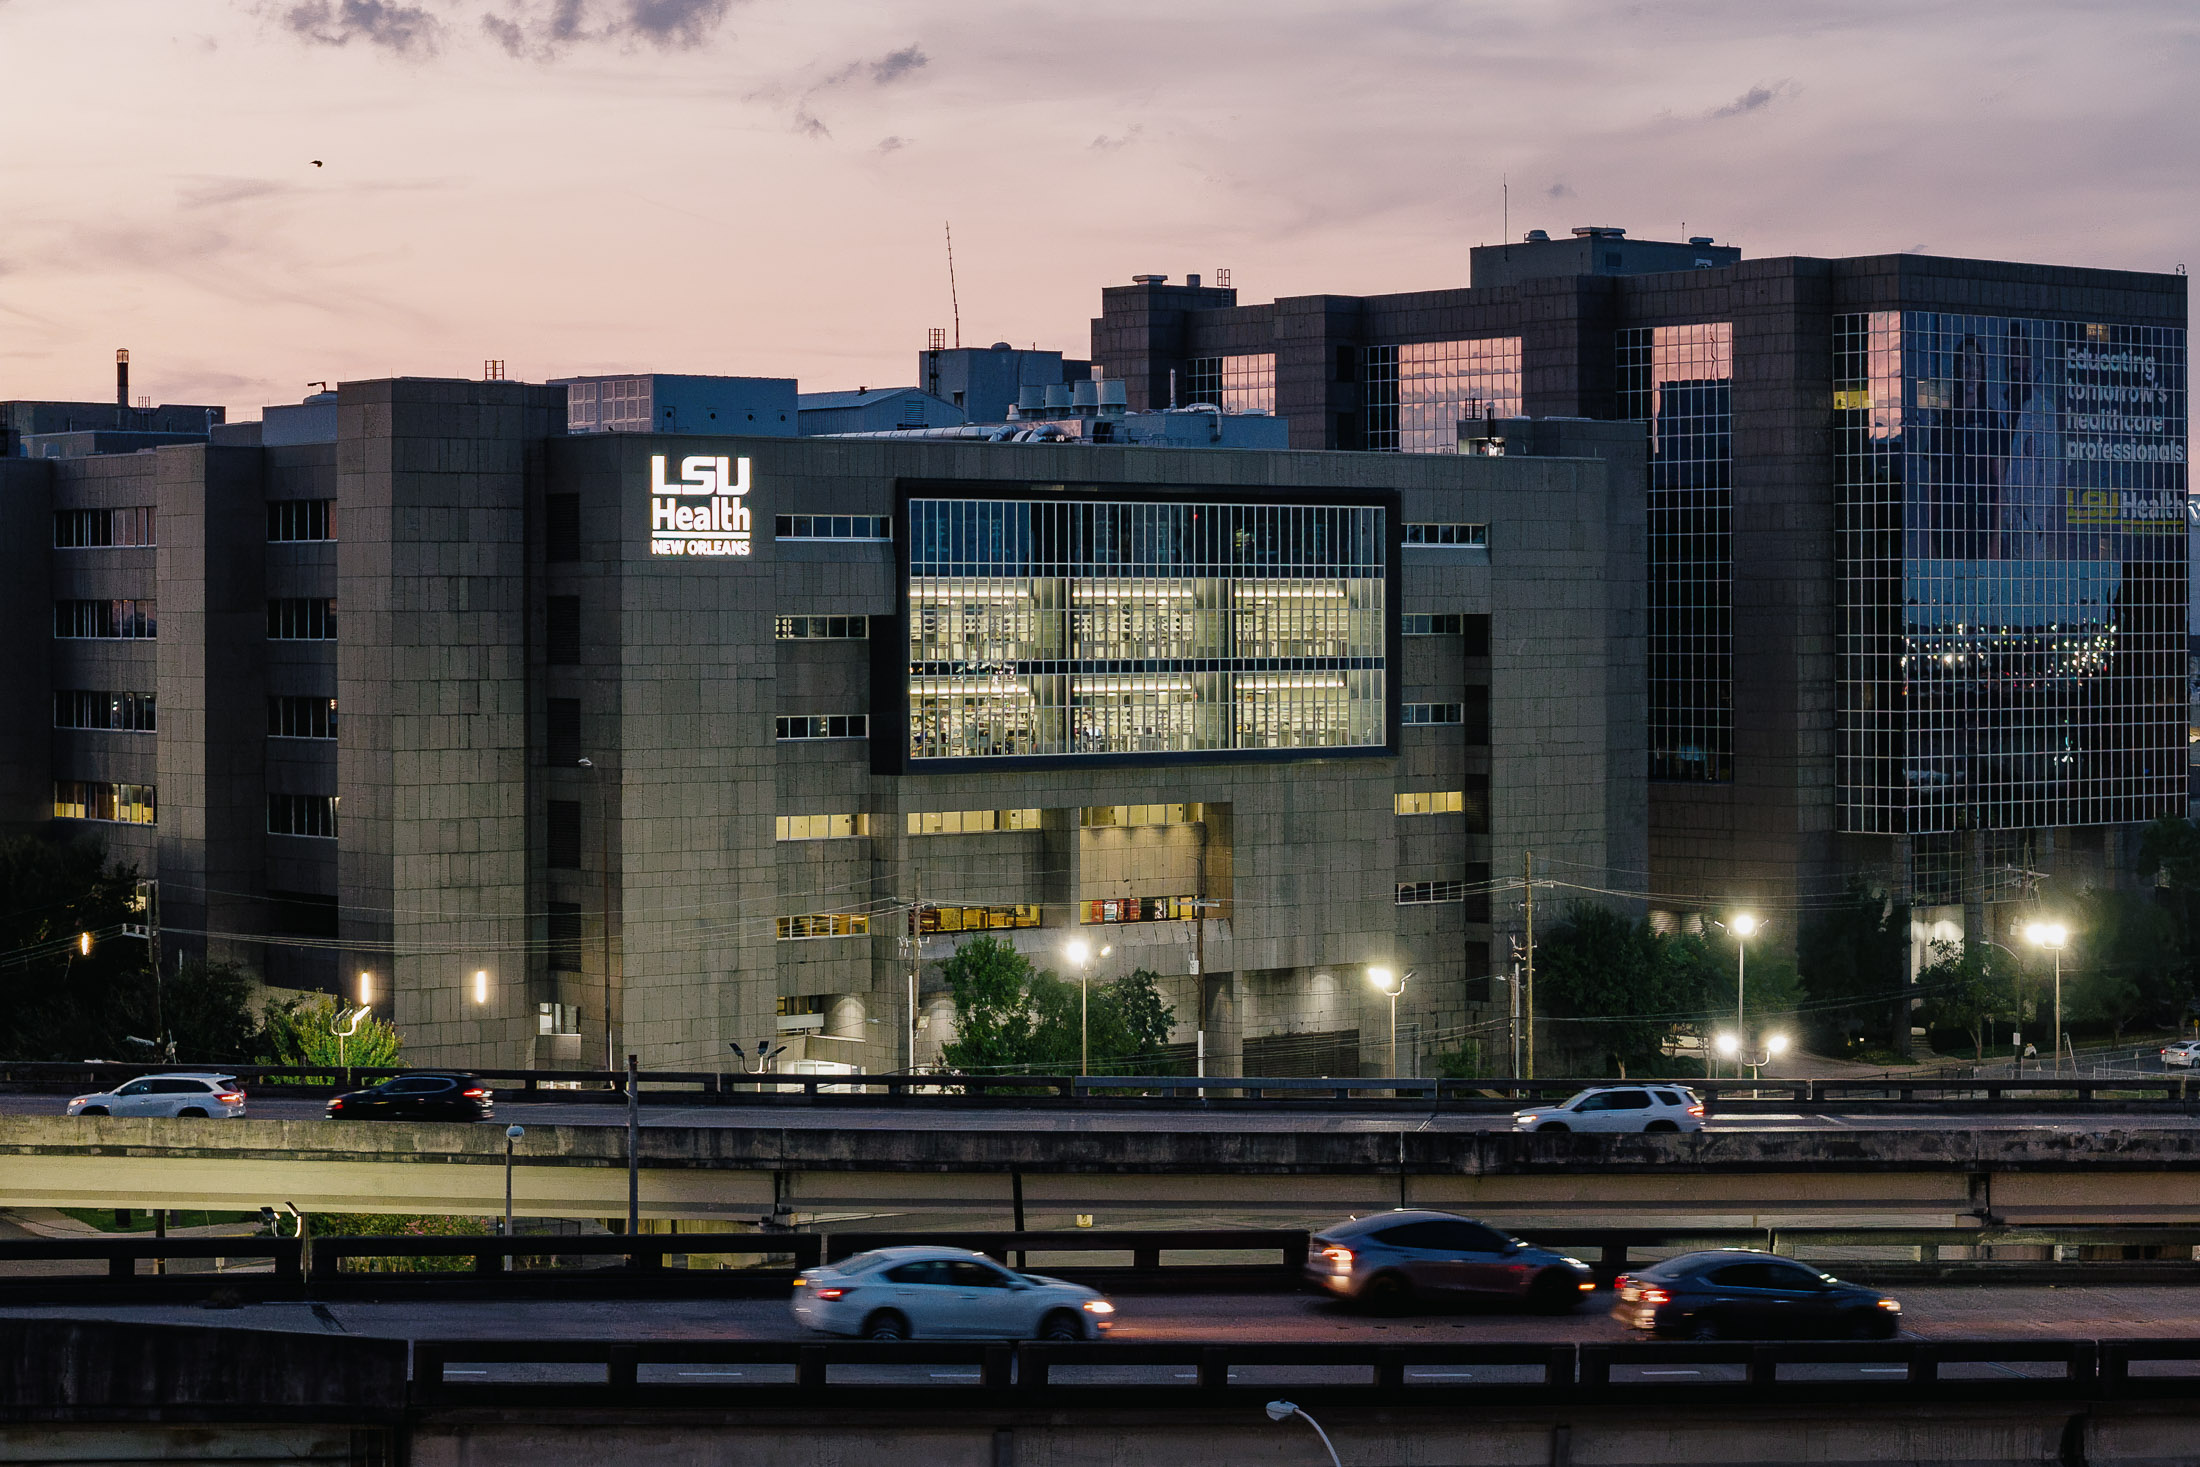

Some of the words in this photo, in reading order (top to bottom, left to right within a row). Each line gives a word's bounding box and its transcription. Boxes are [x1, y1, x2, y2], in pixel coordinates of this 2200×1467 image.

[2067, 348, 2156, 380] Educating
[2067, 377, 2168, 403] tomorrow's
[2067, 406, 2163, 432] healthcare
[2067, 436, 2184, 466] professionals
[651, 455, 751, 496] LSU
[651, 496, 751, 531] Health
[2066, 490, 2119, 517] LSU
[2122, 491, 2184, 519] Health
[651, 539, 686, 555] NEW
[687, 540, 751, 556] ORLEANS
